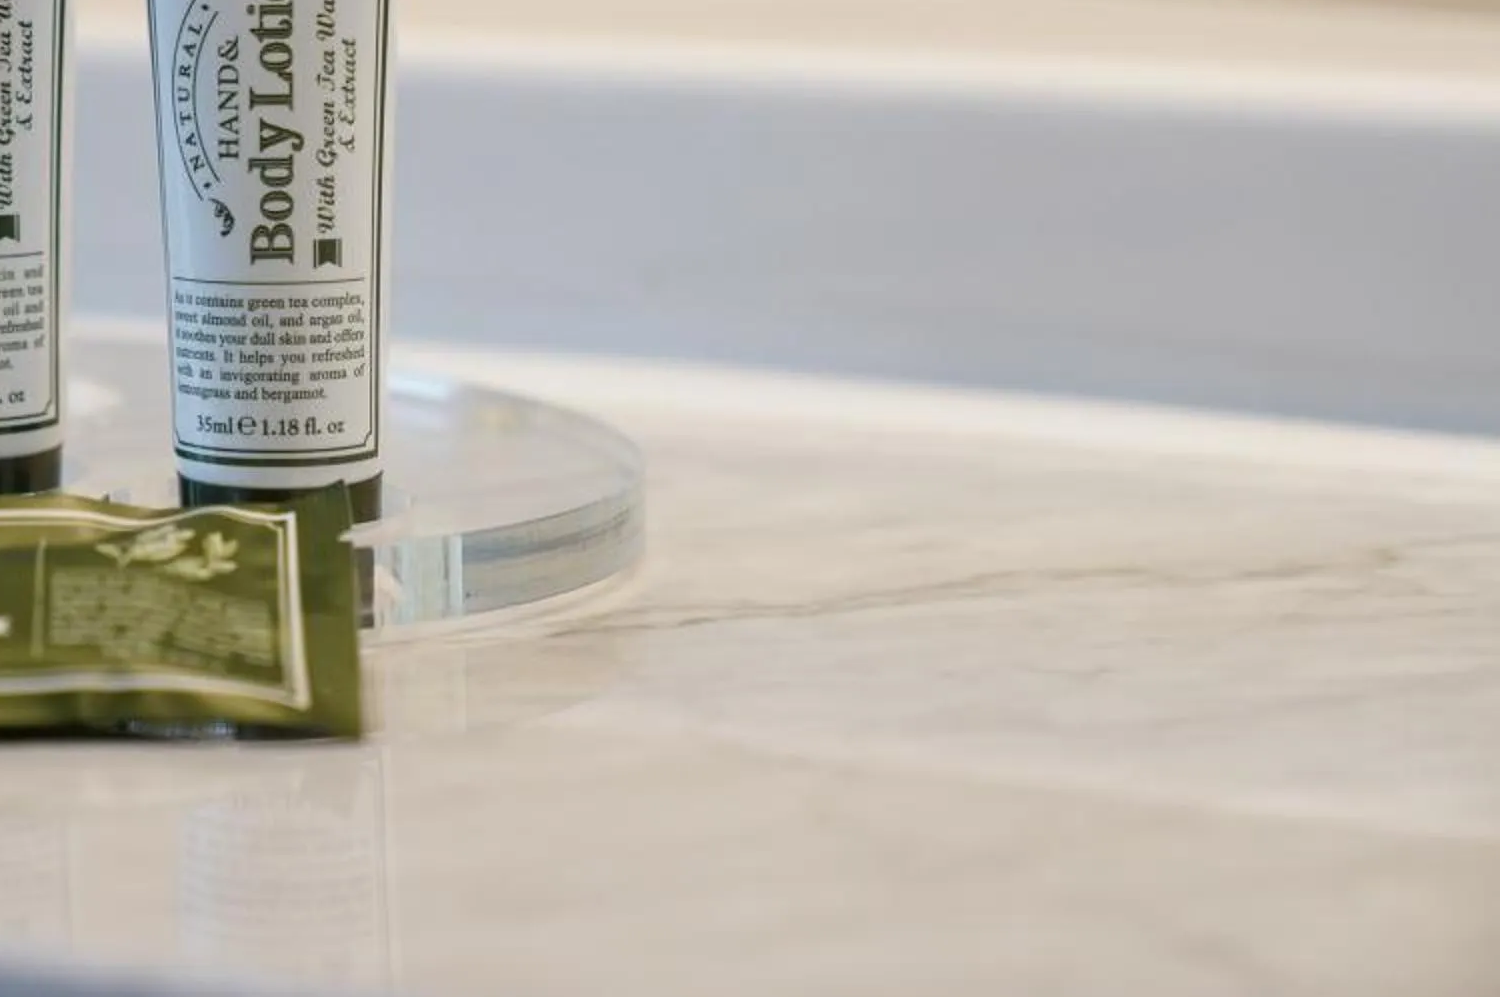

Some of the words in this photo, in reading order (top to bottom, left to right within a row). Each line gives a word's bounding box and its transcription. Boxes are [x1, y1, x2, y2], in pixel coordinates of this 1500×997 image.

[16, 20, 33, 105] Extract
[316, 50, 335, 91] Tea
[339, 38, 356, 125] Extract
[177, 23, 205, 172] NATURAL
[217, 35, 239, 160] HAND&
[316, 100, 338, 168] Green
[248, 117, 305, 266] Body
[316, 175, 335, 234] With
[3, 303, 20, 315] oil
[195, 293, 244, 308] contains
[248, 297, 284, 311] green
[289, 297, 308, 308] tea
[311, 291, 364, 308] complex,
[202, 313, 246, 327] almond
[251, 314, 274, 328] oil,
[279, 313, 303, 326] and
[310, 315, 343, 328] argan
[219, 333, 247, 347] your
[250, 332, 275, 345] dull
[279, 332, 306, 345] skin
[310, 331, 331, 344] and
[224, 350, 233, 363] It
[239, 351, 274, 366] helps
[281, 353, 305, 366] you
[311, 346, 364, 362] refreshed
[220, 367, 300, 385] invigorating
[309, 368, 347, 380] aroma
[354, 363, 365, 377] of
[8, 390, 25, 403] oz
[234, 387, 257, 400] and
[261, 386, 327, 404] bergamot.
[196, 414, 233, 434] 35ml
[262, 419, 299, 436] 1.18
[305, 417, 321, 435] fl.
[327, 420, 345, 433] oz
